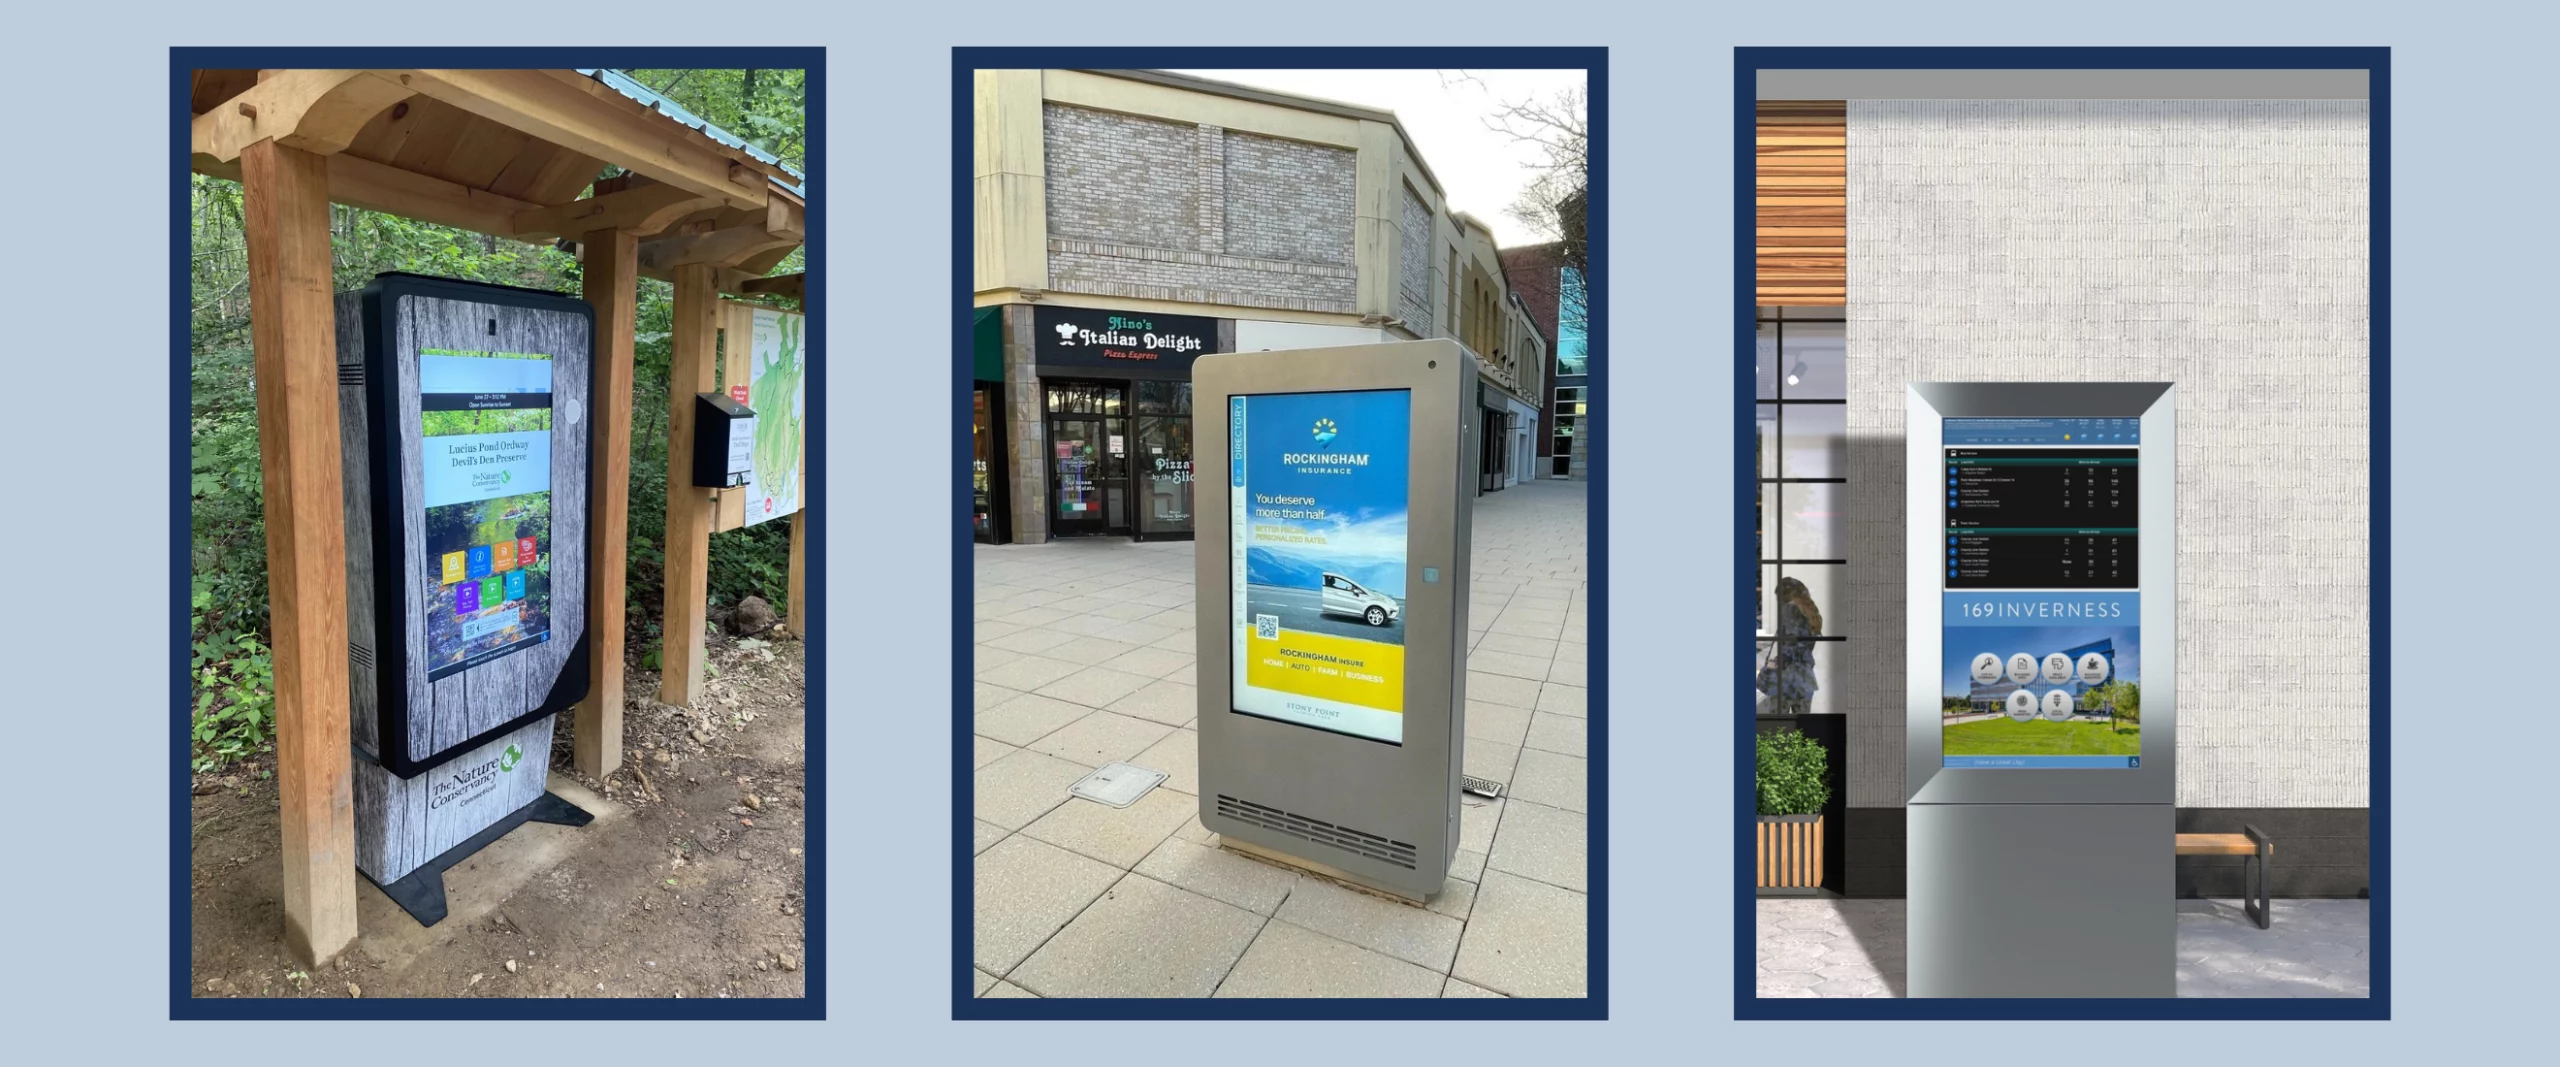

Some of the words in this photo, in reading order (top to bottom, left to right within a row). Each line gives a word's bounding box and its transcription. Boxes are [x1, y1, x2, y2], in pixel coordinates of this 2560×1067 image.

[1108, 316, 1152, 330] Nino's
[1079, 329, 1137, 347] Italian
[1143, 333, 1201, 352] Delight
[1103, 349, 1126, 358] Pizza
[1128, 350, 1159, 360] Express
[1234, 404, 1244, 460] DIRECTORY
[449, 444, 477, 455] Lucius
[479, 441, 500, 452] Pond
[500, 439, 530, 451] Ordway
[452, 455, 478, 467] Devil's
[479, 455, 495, 465] Den
[496, 453, 527, 464] Preserve
[1155, 458, 1190, 471] Pizza
[1283, 453, 1368, 466] ROCKINGHAM
[480, 471, 500, 481] Nature
[1152, 473, 1160, 481] by
[1172, 470, 1195, 484] Slic
[1297, 467, 1352, 475] INSURANCE
[1256, 493, 1273, 505] You
[1275, 494, 1315, 506] deserve
[1255, 510, 1280, 518] more
[1282, 509, 1304, 519] than
[1306, 509, 1327, 520] half.
[1962, 602, 1994, 618] 169
[1998, 602, 2121, 618] INVERNESS
[1280, 648, 1337, 663] ROCKINGHAM
[1338, 659, 1364, 667] INSURE
[1263, 658, 1284, 668] HOME
[1291, 662, 1310, 672] AUTO
[1318, 667, 1338, 676] FARM
[1346, 671, 1384, 683] BUSINESS
[1286, 702, 1312, 712] STONY
[1315, 708, 1341, 718] POINT
[432, 782, 452, 796] The
[451, 757, 499, 790] Nature
[431, 769, 498, 809] Conservancy
[460, 783, 497, 807] Connecticut
